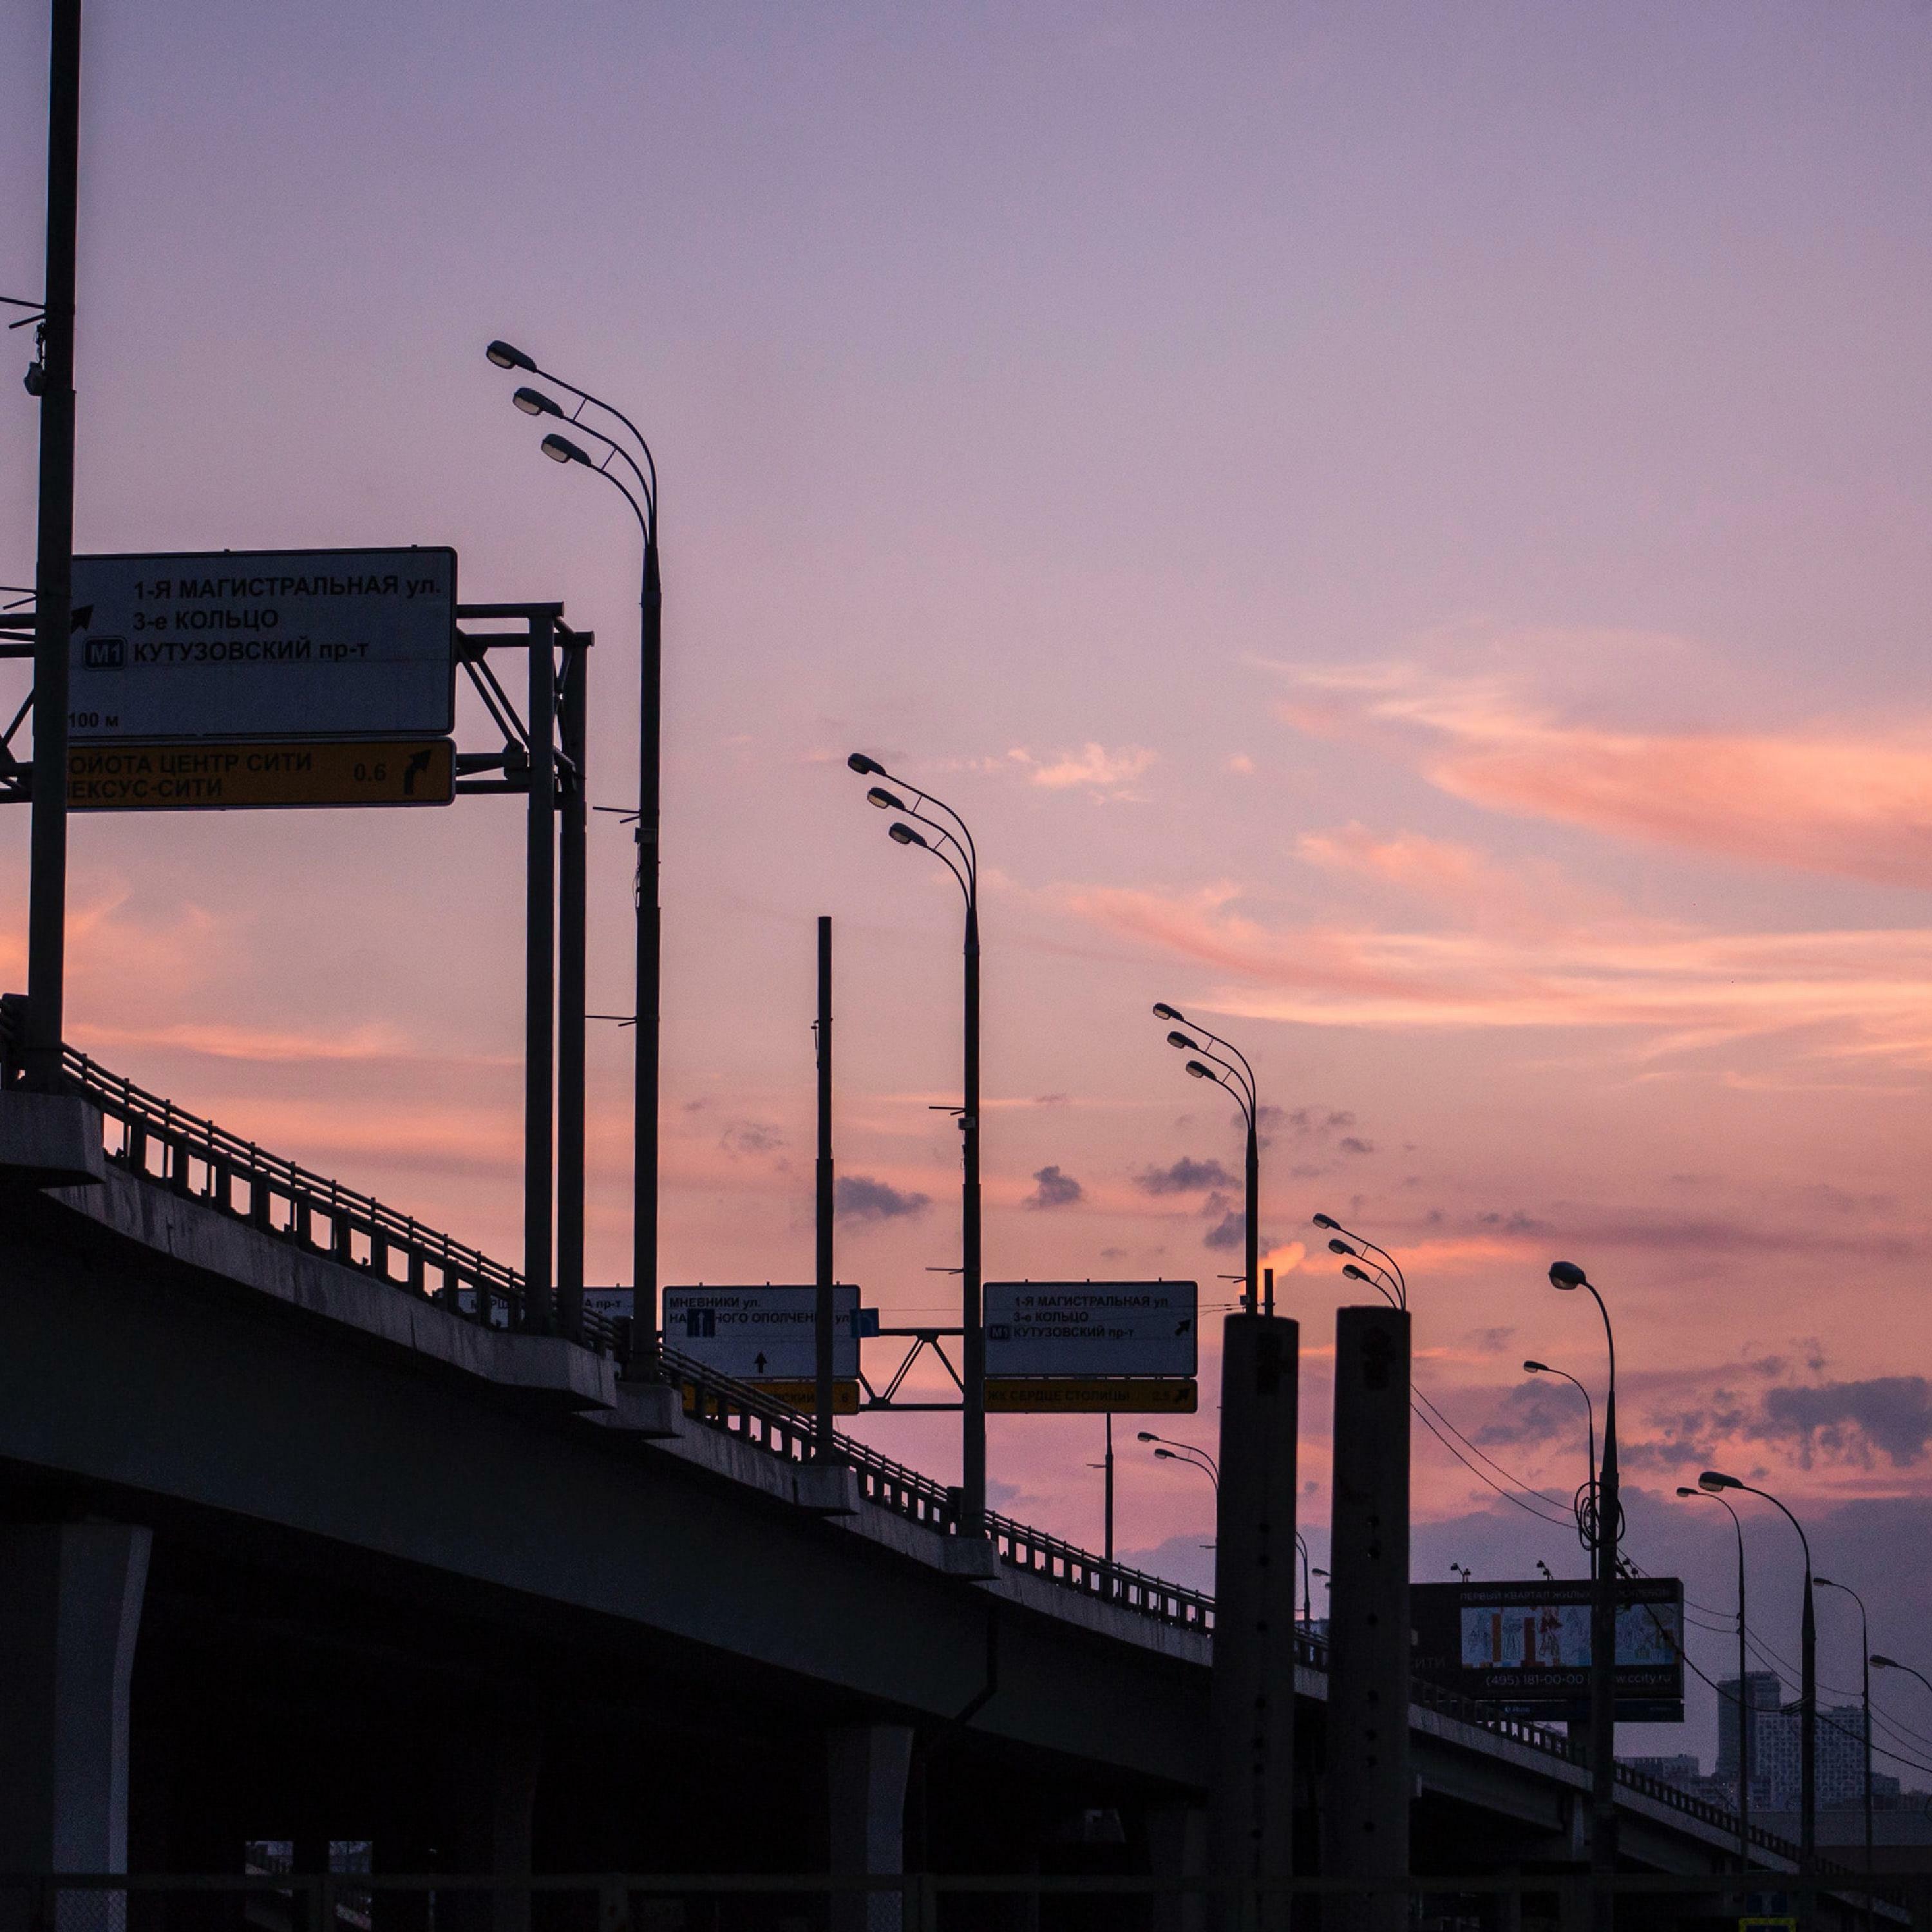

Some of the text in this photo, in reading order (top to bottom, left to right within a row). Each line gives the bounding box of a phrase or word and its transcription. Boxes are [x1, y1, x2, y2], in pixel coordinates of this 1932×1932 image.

[134, 576, 441, 600] 1-Я МАГИСТРАЛЬНАЯ ул.
[133, 609, 278, 632] 3-е КОЛЬЦО
[134, 636, 369, 662] КУТУЗОВСКИЙ пр-т
[69, 752, 386, 782] ОЙОТА ЦЕНТР СИТИ 0.6
[67, 778, 222, 799] ЕКСУС-СИТИ
[669, 1297, 740, 1308] МНЕВНИКИ
[1015, 1296, 1034, 1307] 1-Я
[1037, 1296, 1150, 1307] МАГИСТРАЛЬНАЯ
[669, 1313, 748, 1323] НАНОГО
[751, 1312, 817, 1323] ОПОЛЧЕН
[1014, 1311, 1089, 1322] 3-е КОЛЬЦО
[1013, 1325, 1105, 1338] КУТУЗОВСКИЙ
[1010, 1389, 1061, 1403] СЕРДЦЕ
[1065, 1389, 1130, 1403] СТОЛИЦЫ
[1504, 1591, 1549, 1600] КВАРТАЛ
[1485, 1674, 1520, 1687] (495)
[1523, 1673, 1584, 1685] 181-00-00
